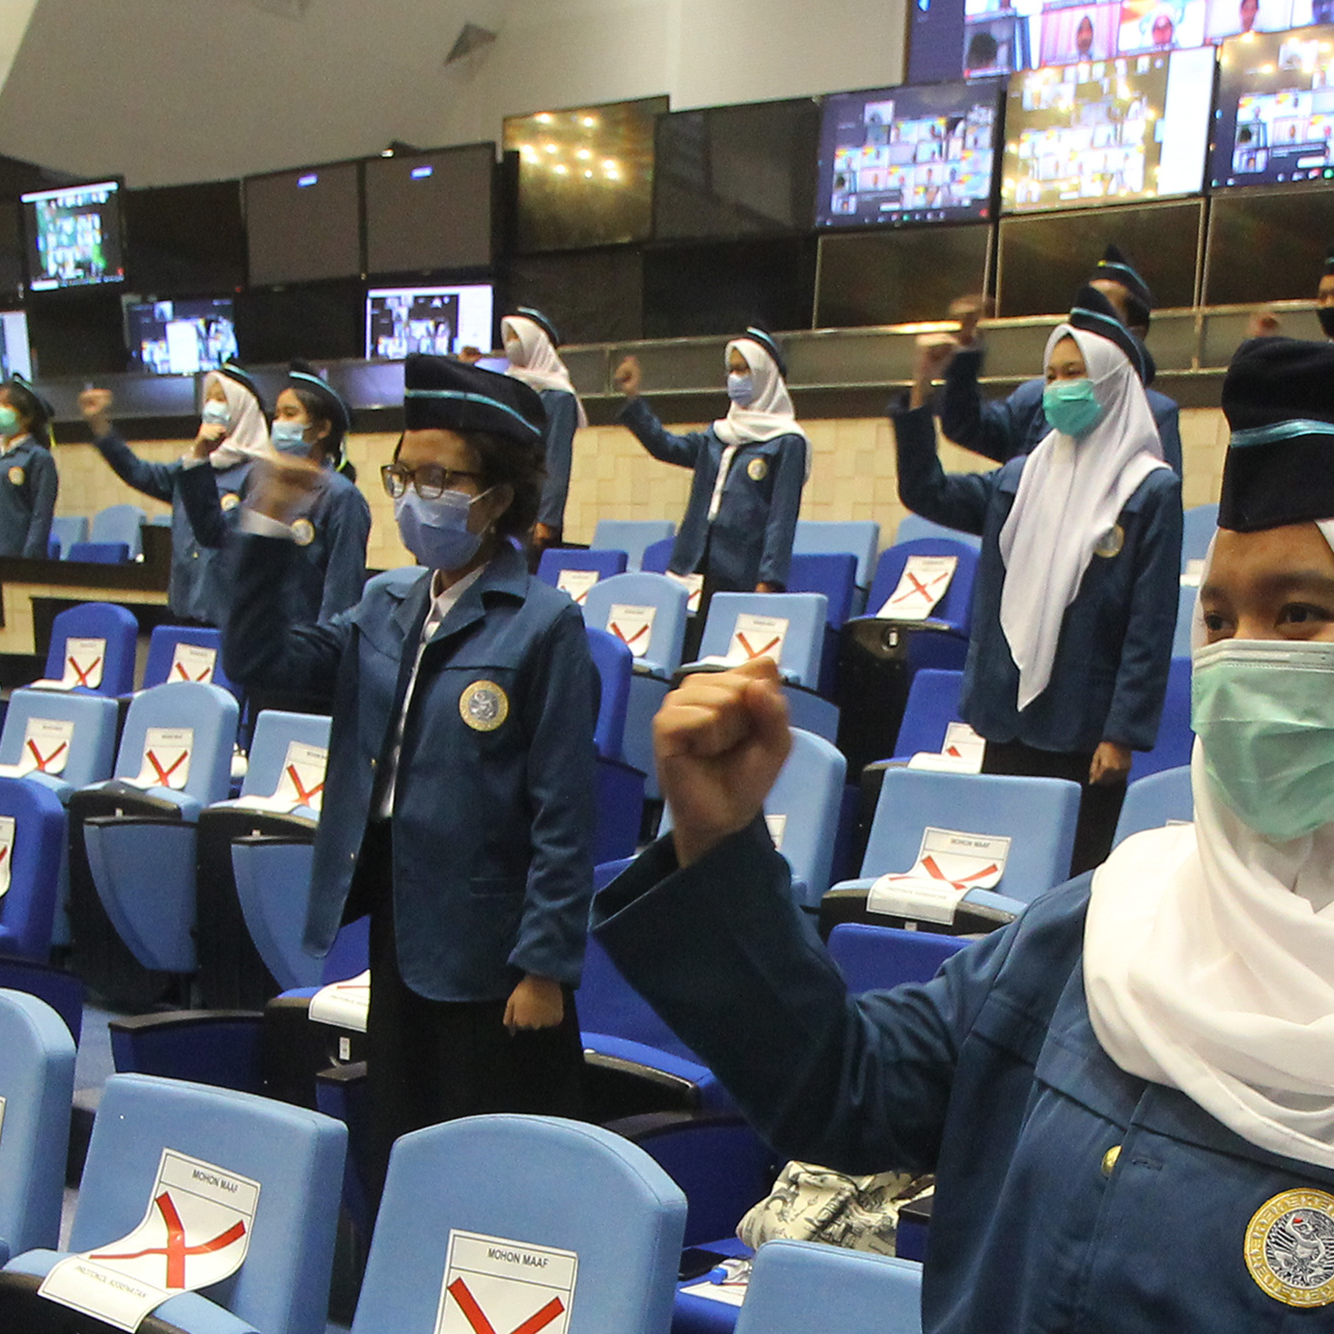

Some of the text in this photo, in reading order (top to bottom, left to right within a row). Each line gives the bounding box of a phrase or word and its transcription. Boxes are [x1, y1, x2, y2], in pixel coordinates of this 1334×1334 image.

[192, 1169, 240, 1193] MOHON MAAF
[488, 1248, 550, 1268] MOHON MAAF
